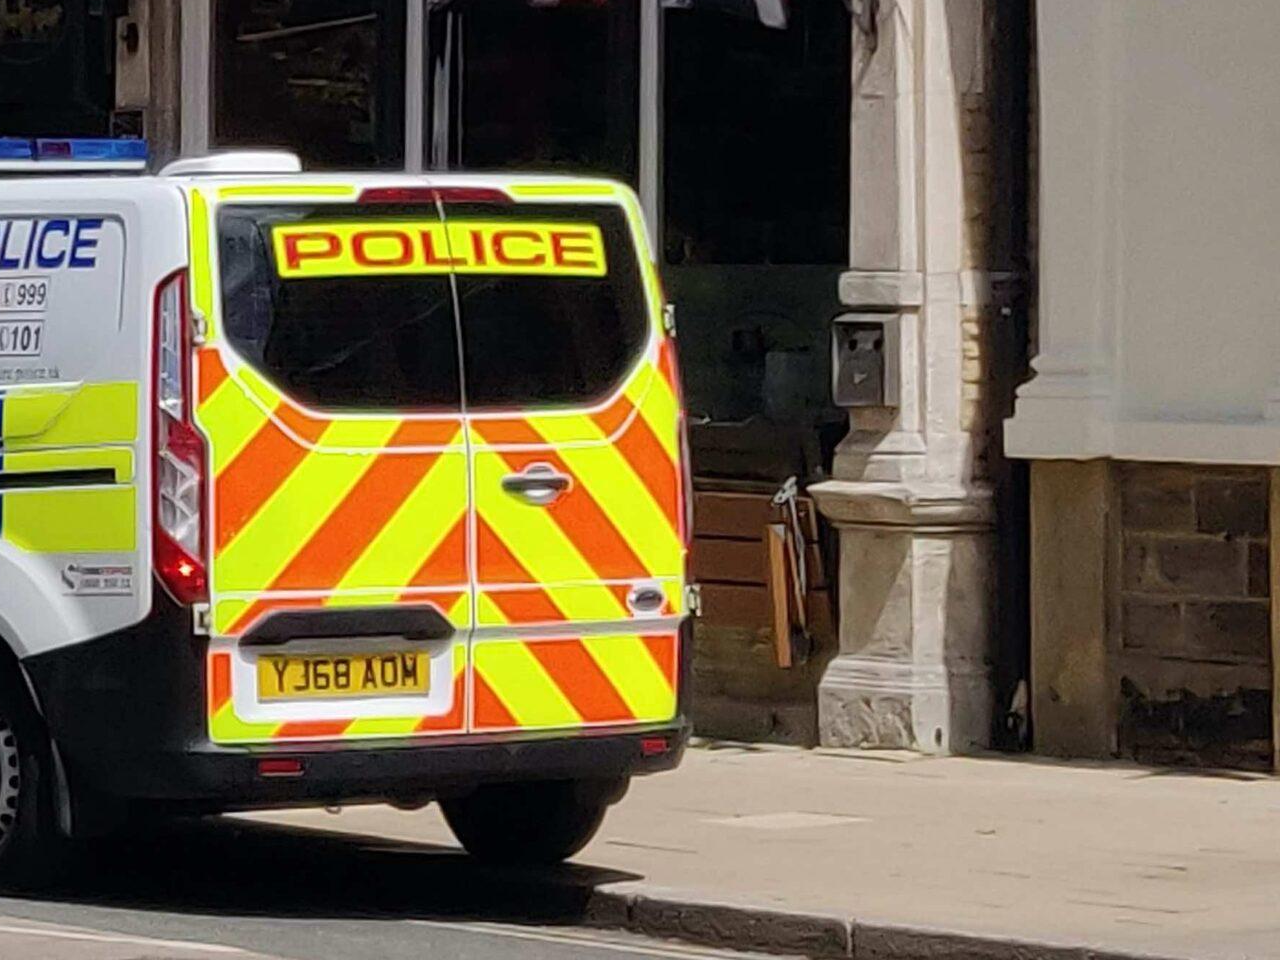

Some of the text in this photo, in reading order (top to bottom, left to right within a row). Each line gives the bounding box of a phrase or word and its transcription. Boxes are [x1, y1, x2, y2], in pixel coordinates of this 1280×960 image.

[281, 229, 599, 270] POLICE
[17, 282, 47, 306] 999
[12, 325, 41, 351] 101
[272, 653, 419, 693] YJ68 AOM
